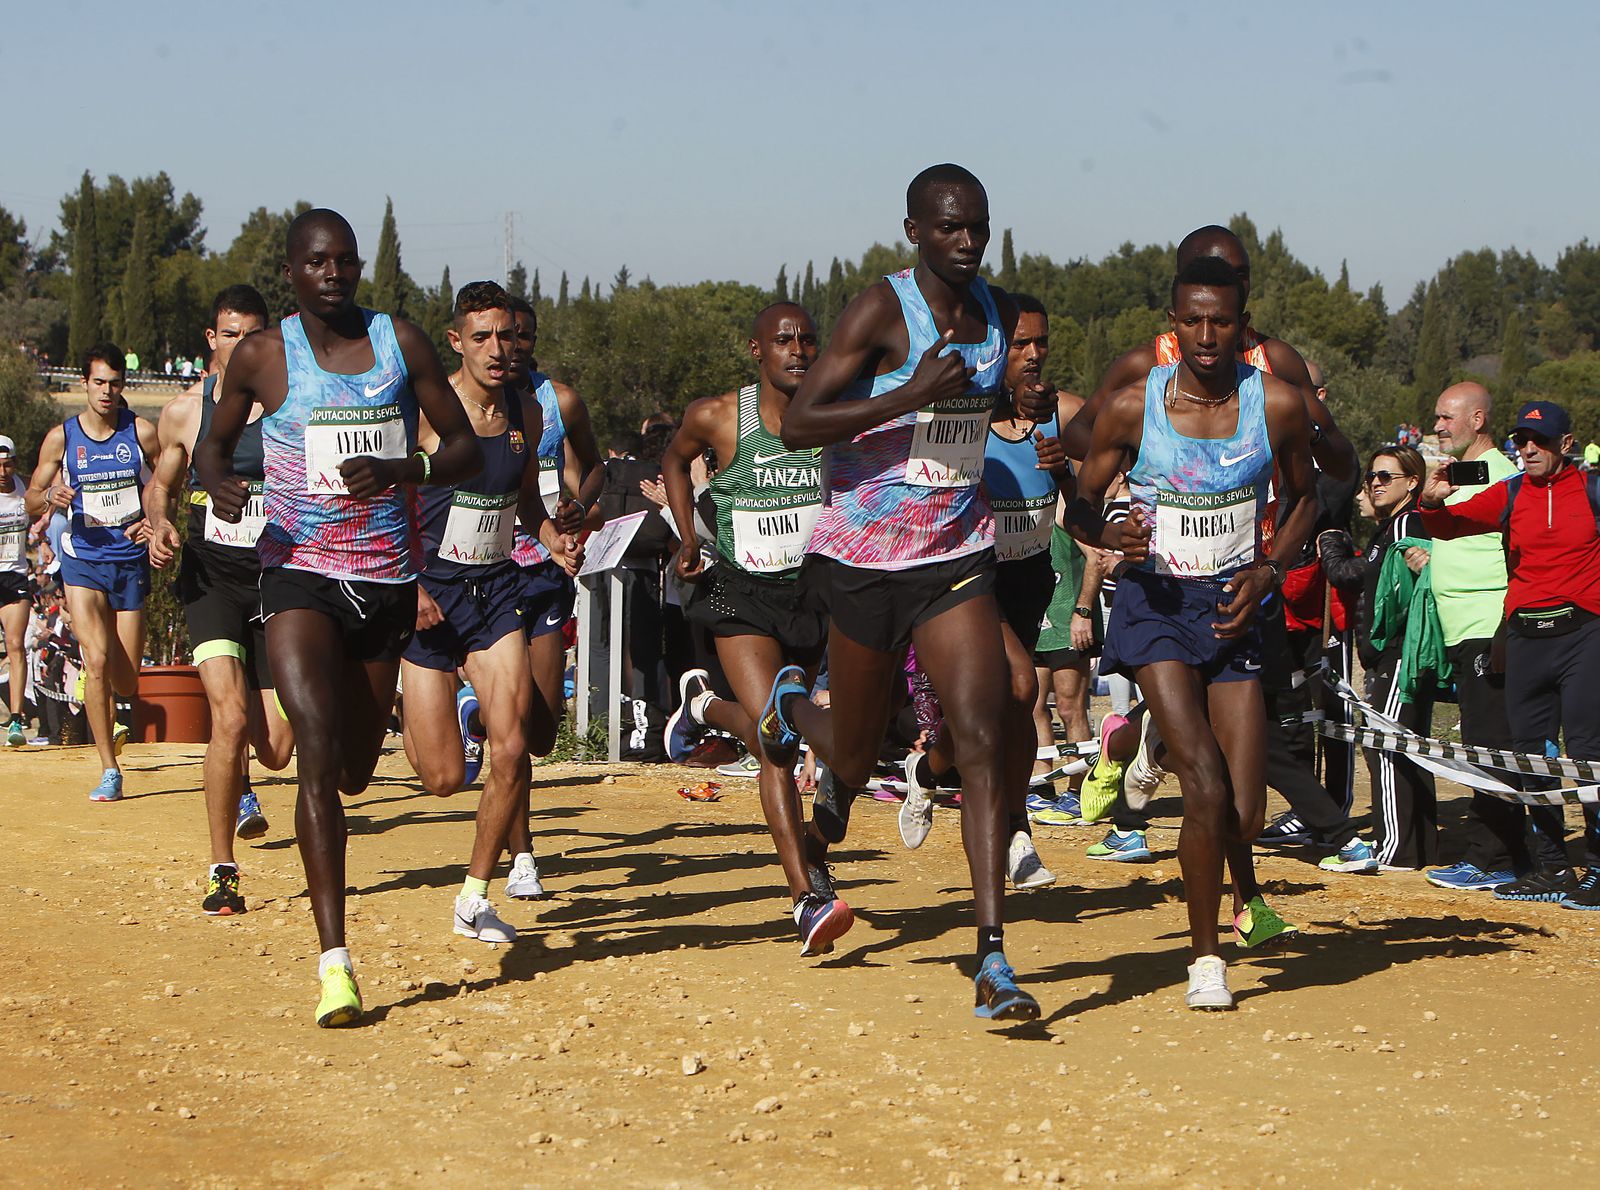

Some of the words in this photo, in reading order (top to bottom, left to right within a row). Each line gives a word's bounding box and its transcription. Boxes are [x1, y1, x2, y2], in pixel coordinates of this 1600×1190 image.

[363, 410, 375, 420] DE
[335, 430, 382, 454] AYEKO
[253, 484, 263, 492] DE
[1160, 492, 1212, 506] DIPUTACION
[1214, 495, 1225, 504] DE
[1226, 487, 1254, 502] SEVILLA
[101, 493, 121, 507] ARCE
[456, 494, 498, 507] DIPUTACION
[735, 497, 779, 508] DIPUTACION
[781, 497, 791, 505] DE
[793, 490, 822, 503] SEVILLA
[757, 513, 799, 537] GINIKI
[1003, 514, 1038, 534] HADIS
[1181, 512, 1235, 538] BAREGA
